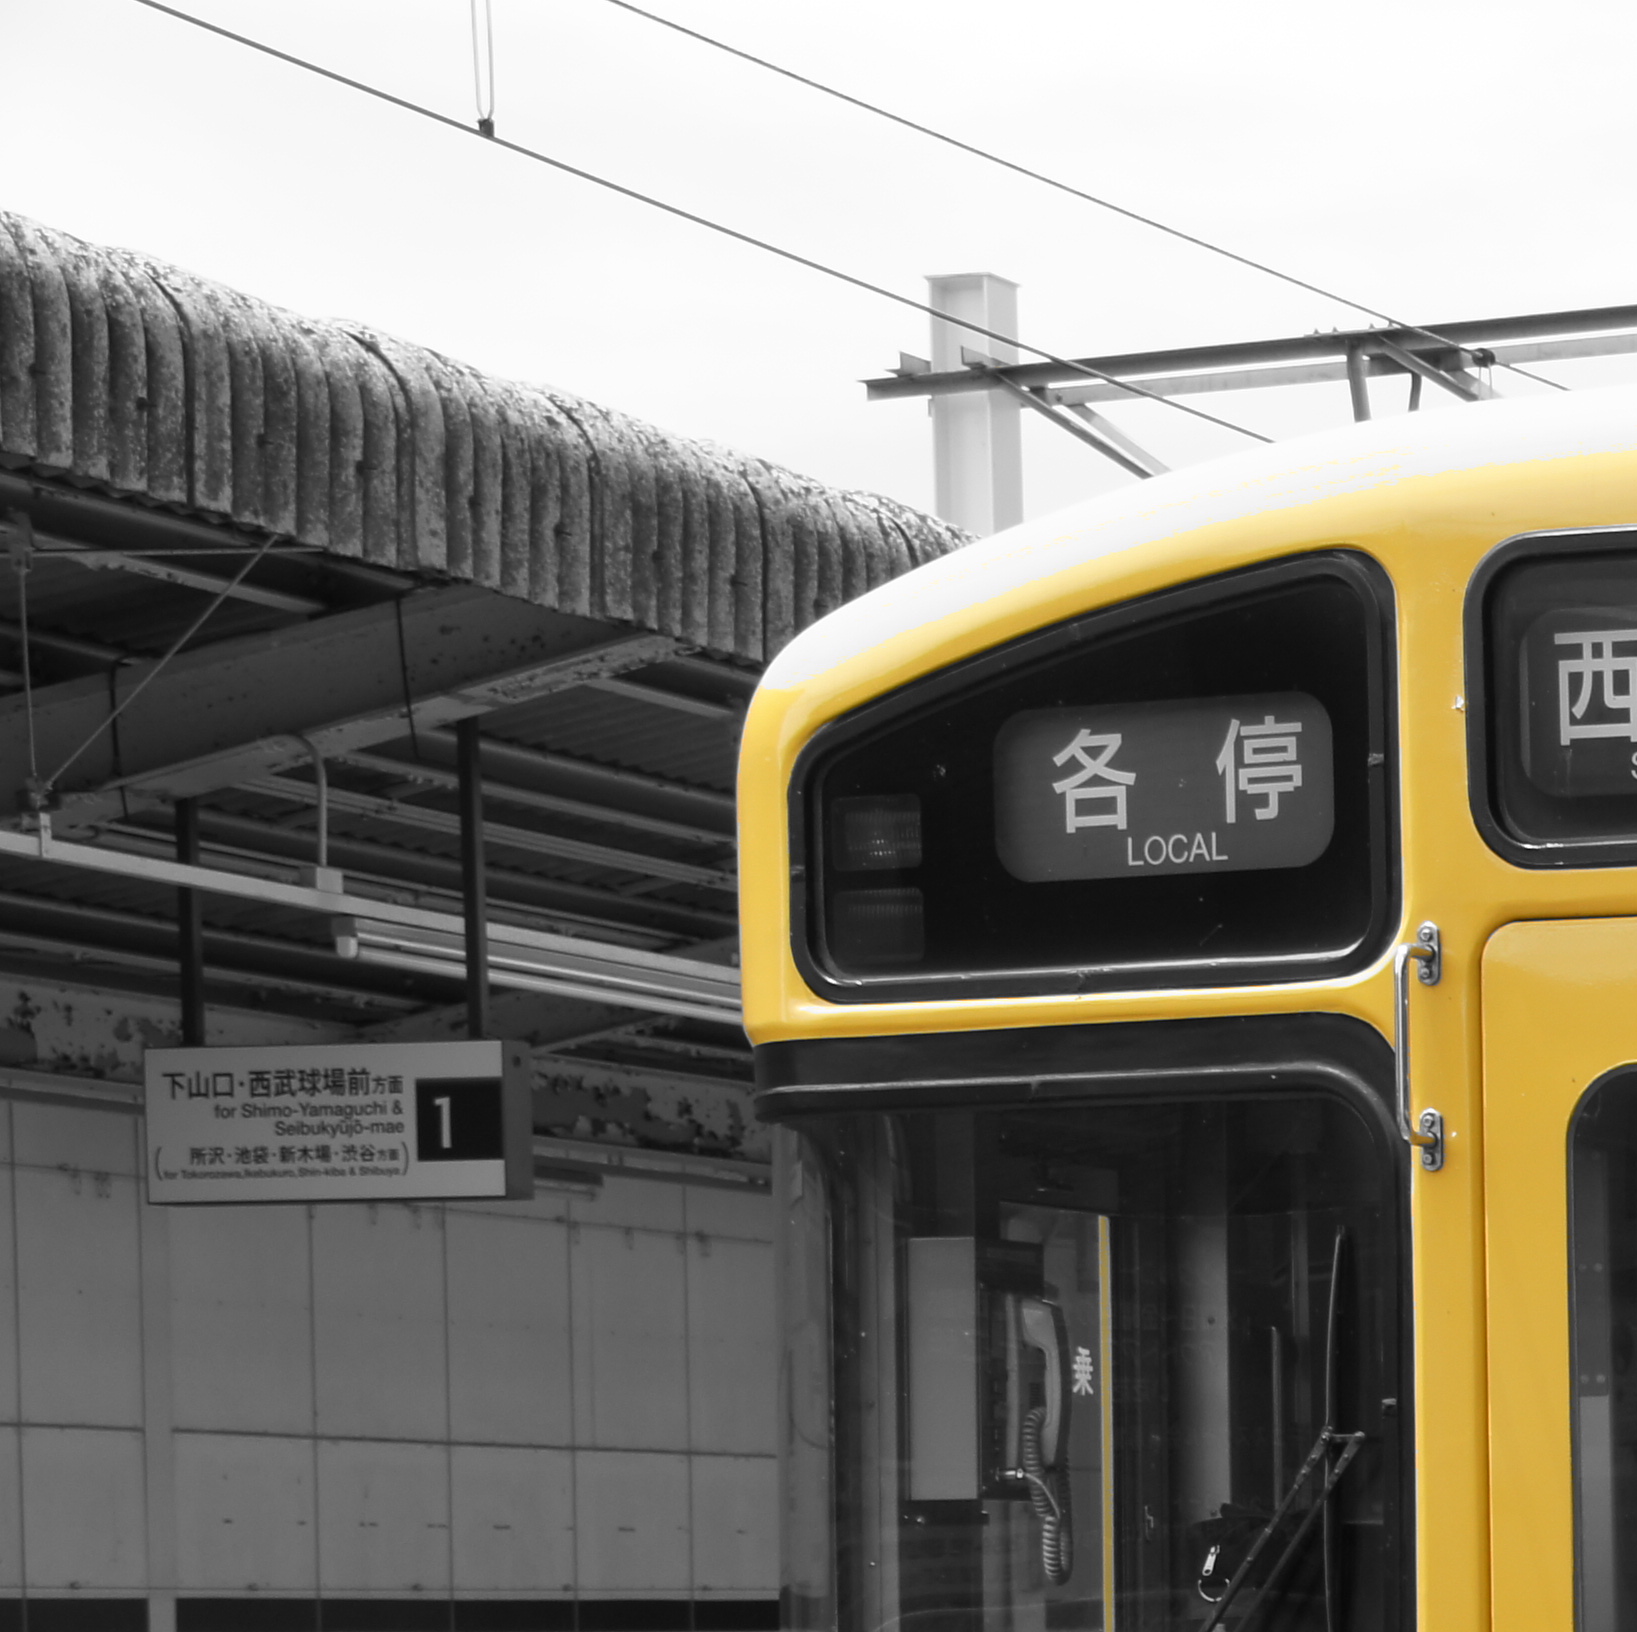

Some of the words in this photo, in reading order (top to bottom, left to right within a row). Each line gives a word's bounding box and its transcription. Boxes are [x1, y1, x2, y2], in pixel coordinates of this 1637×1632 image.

[1127, 831, 1229, 866] LOCAL
[214, 1103, 237, 1119] for
[241, 1101, 388, 1119] Shimo-Yamaguchi
[392, 1099, 404, 1115] &
[432, 1095, 453, 1150] 1
